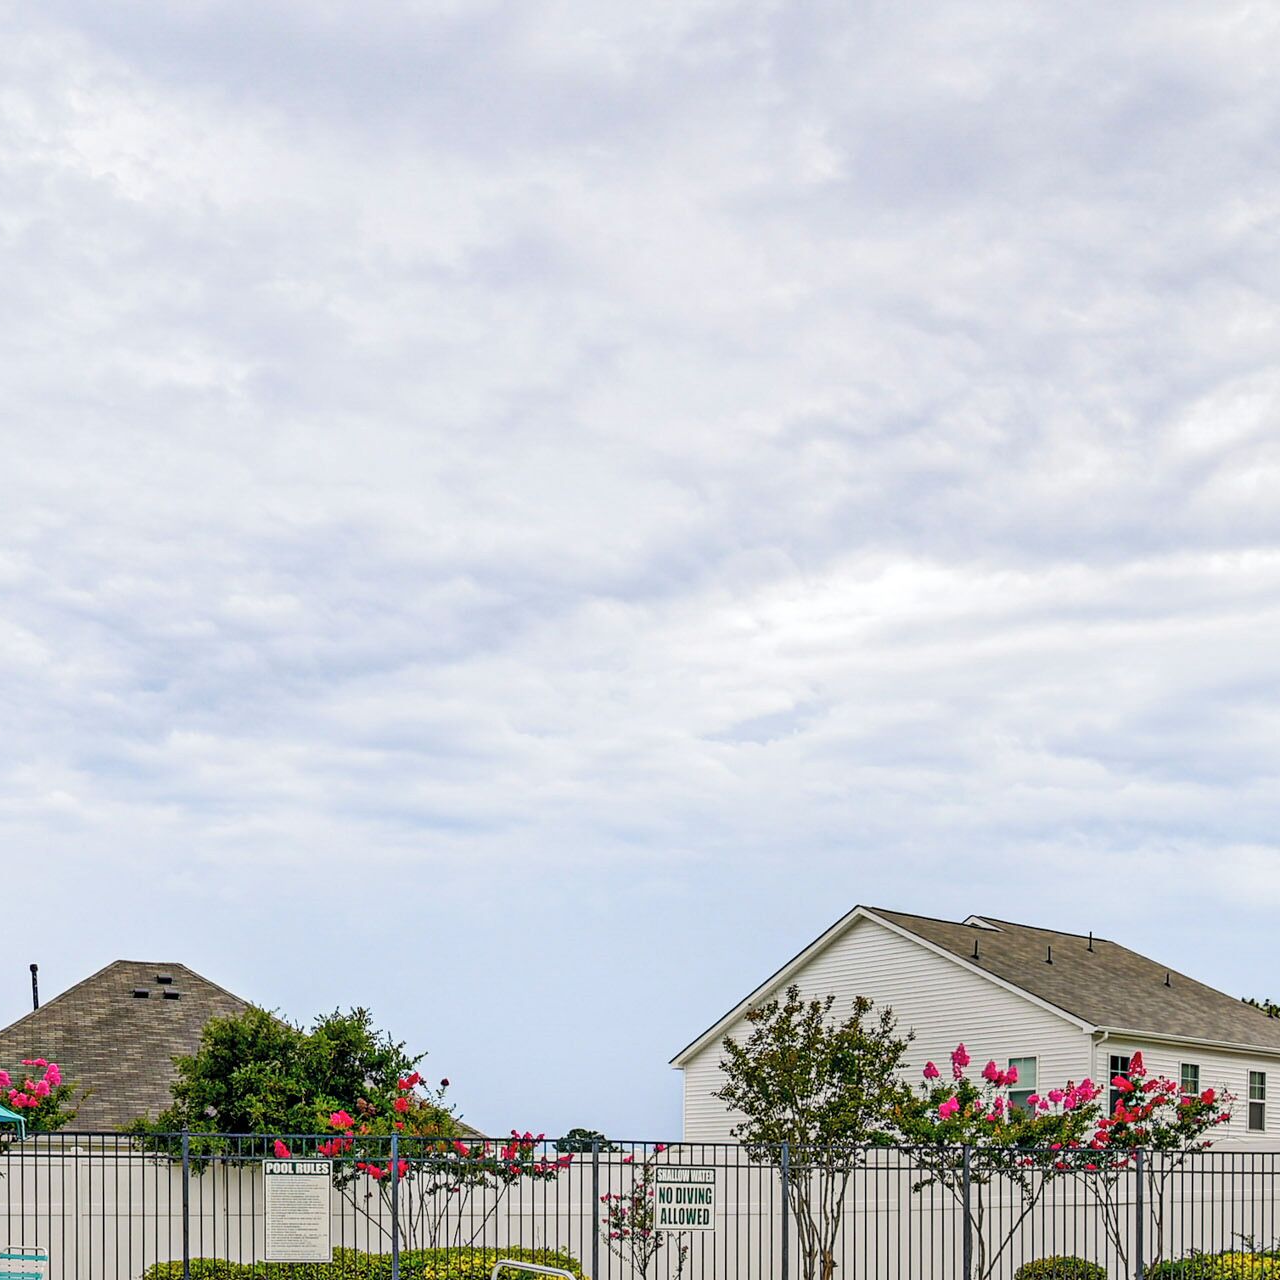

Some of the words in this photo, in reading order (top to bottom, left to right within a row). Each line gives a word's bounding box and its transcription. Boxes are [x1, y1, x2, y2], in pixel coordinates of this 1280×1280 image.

[266, 1162, 294, 1174] POOL
[296, 1163, 329, 1175] RULES
[657, 1168, 690, 1182] SHALLOW
[690, 1170, 714, 1183] WATER
[659, 1187, 673, 1204] NO
[676, 1187, 712, 1205] DIVING
[660, 1207, 710, 1225] ALLOWED
